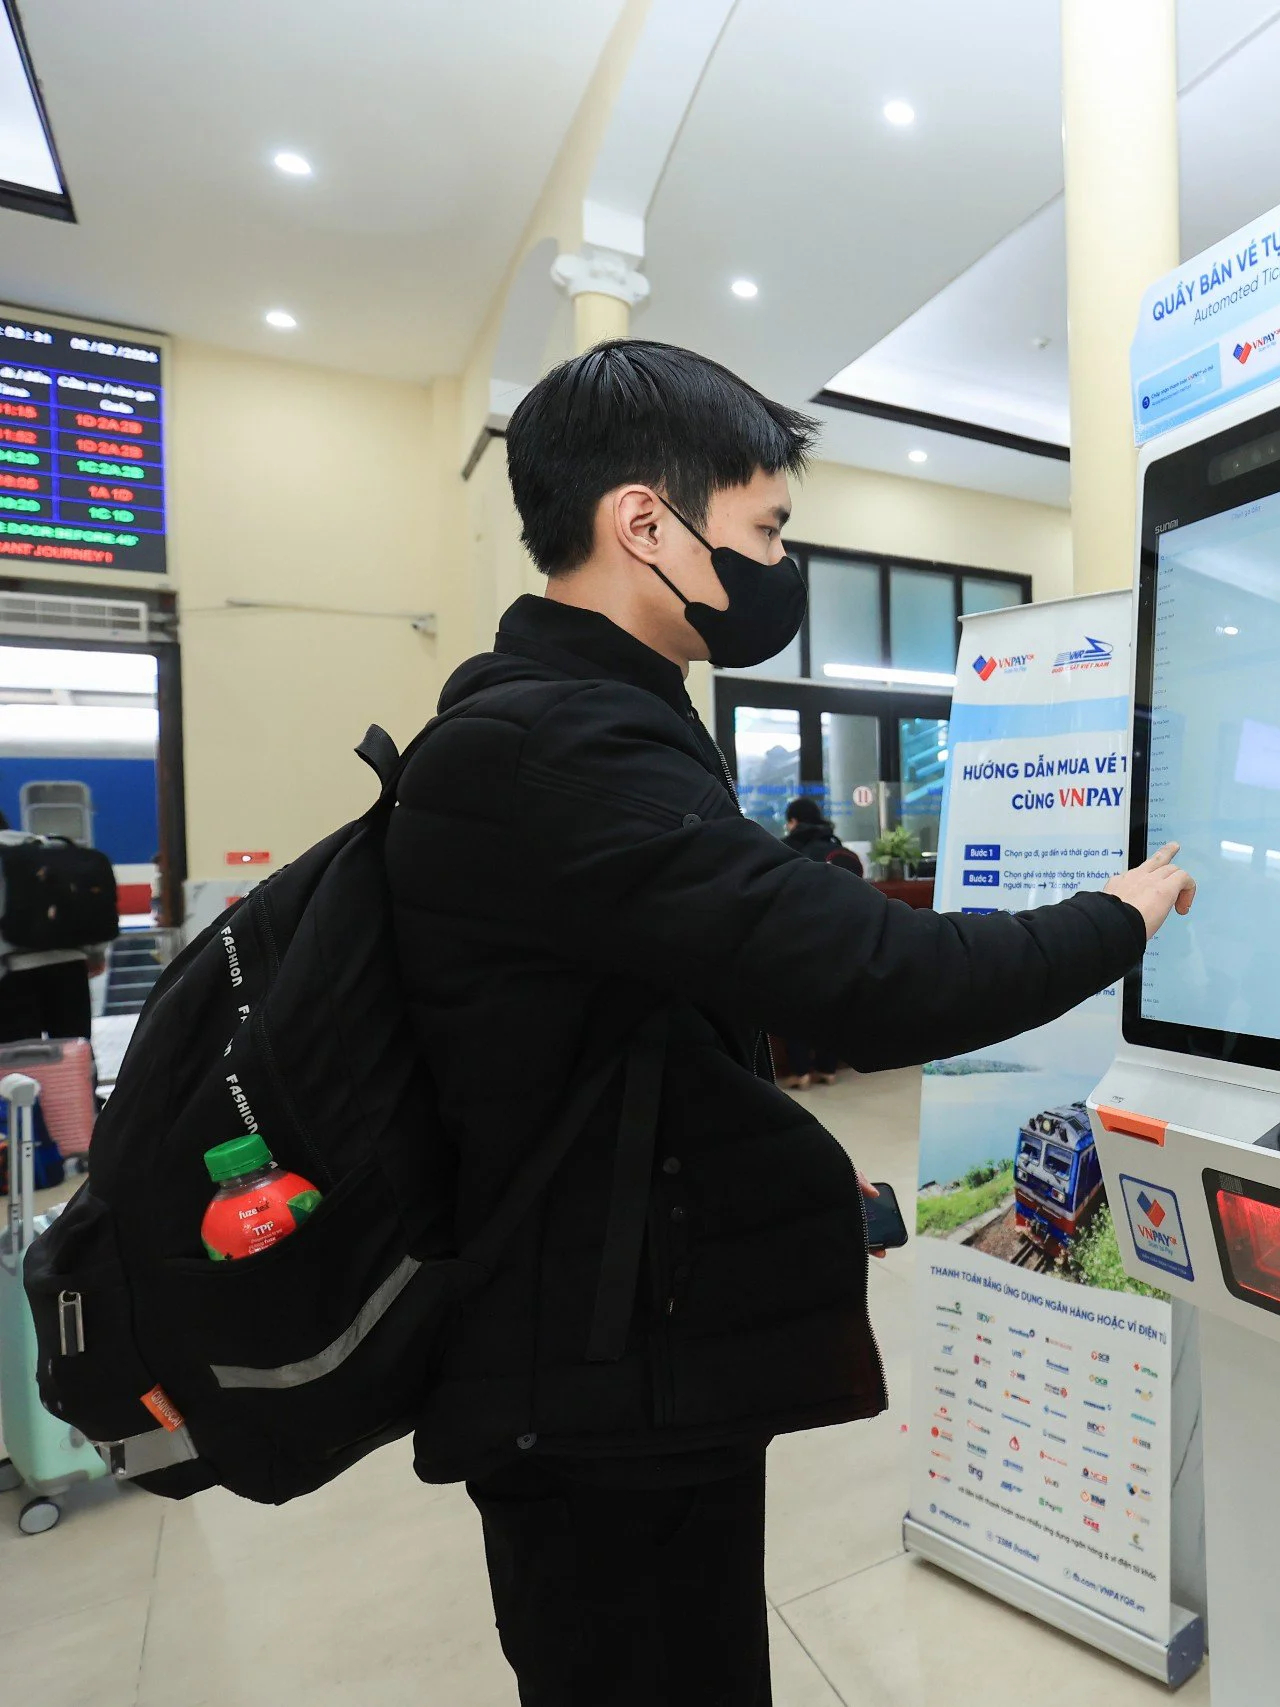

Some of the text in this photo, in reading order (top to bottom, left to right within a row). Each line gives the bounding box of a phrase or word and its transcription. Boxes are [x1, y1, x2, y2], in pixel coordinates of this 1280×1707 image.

[1153, 281, 1195, 321] QUẦY
[1200, 258, 1232, 295] BÁN
[1238, 239, 1257, 272] VÉ
[1193, 276, 1258, 325] Automated
[963, 752, 1116, 780] HƯỚNG DẪN MUA VÉ
[1012, 786, 1124, 810] CÙNG VNPAY
[989, 849, 993, 857] 1
[1004, 849, 1023, 858] Chọn
[1024, 850, 1033, 858] ga
[1083, 849, 1100, 858] gian
[988, 875, 993, 883] 2
[1003, 870, 1022, 879] Chọn
[220, 925, 243, 987] FASHION
[225, 1073, 258, 1134] FASHION
[930, 1266, 960, 1280] THANH
[961, 1271, 982, 1285] TOÁN
[1021, 1291, 1044, 1306] DỤNG
[1044, 1300, 1068, 1315] NGÂN
[1069, 1306, 1095, 1322] HÀNG
[1096, 1315, 1125, 1330] HOẶC
[1127, 1319, 1138, 1332] VÍ
[1138, 1325, 1158, 1340] ĐIỆN
